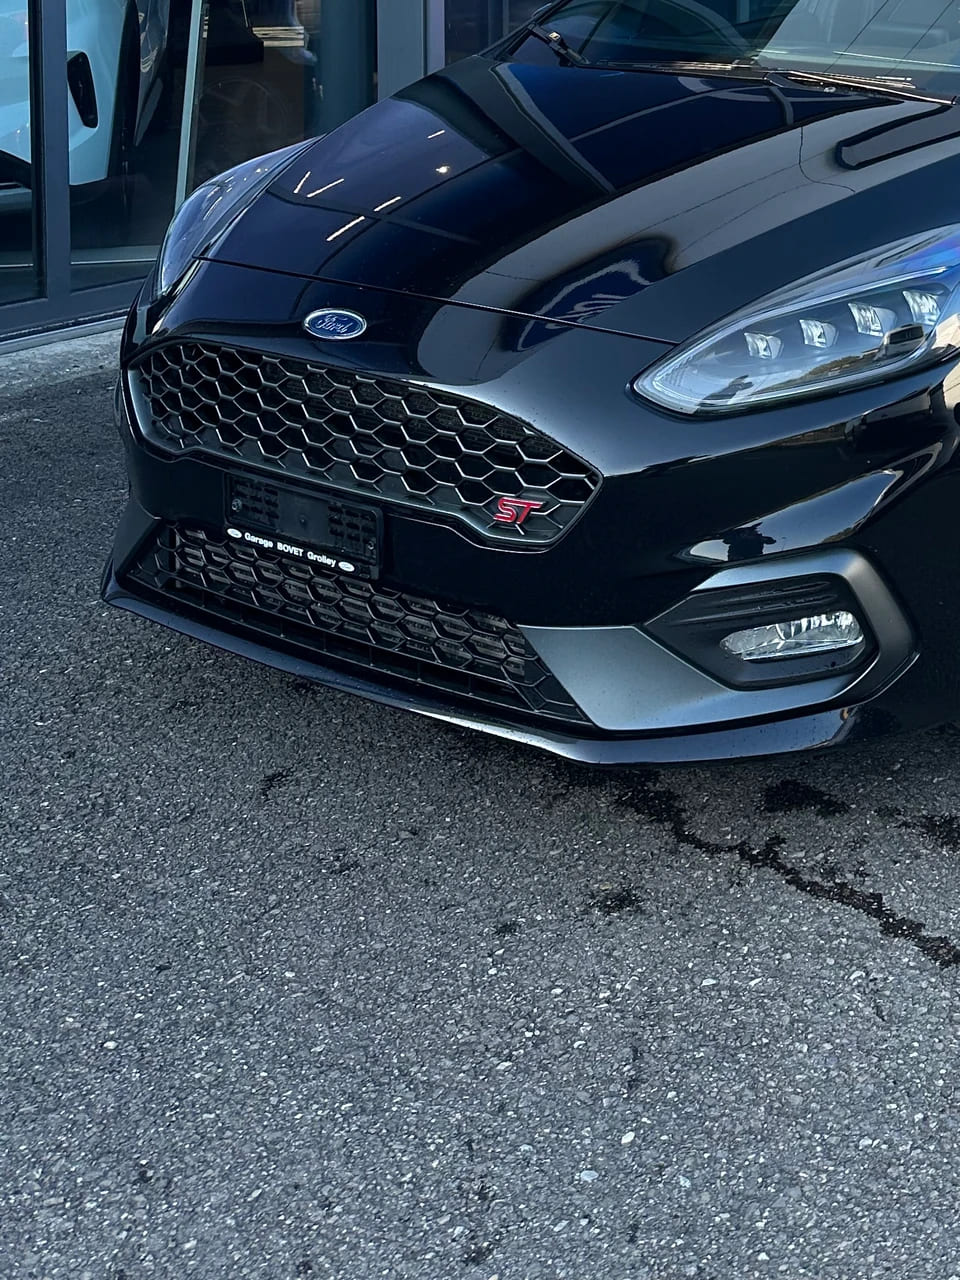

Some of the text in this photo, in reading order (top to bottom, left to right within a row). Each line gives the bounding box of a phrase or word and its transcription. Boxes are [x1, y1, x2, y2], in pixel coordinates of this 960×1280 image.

[493, 496, 544, 524] ST
[244, 532, 273, 548] Garage
[277, 541, 304, 557] BOVET
[307, 551, 337, 568] Grolley
